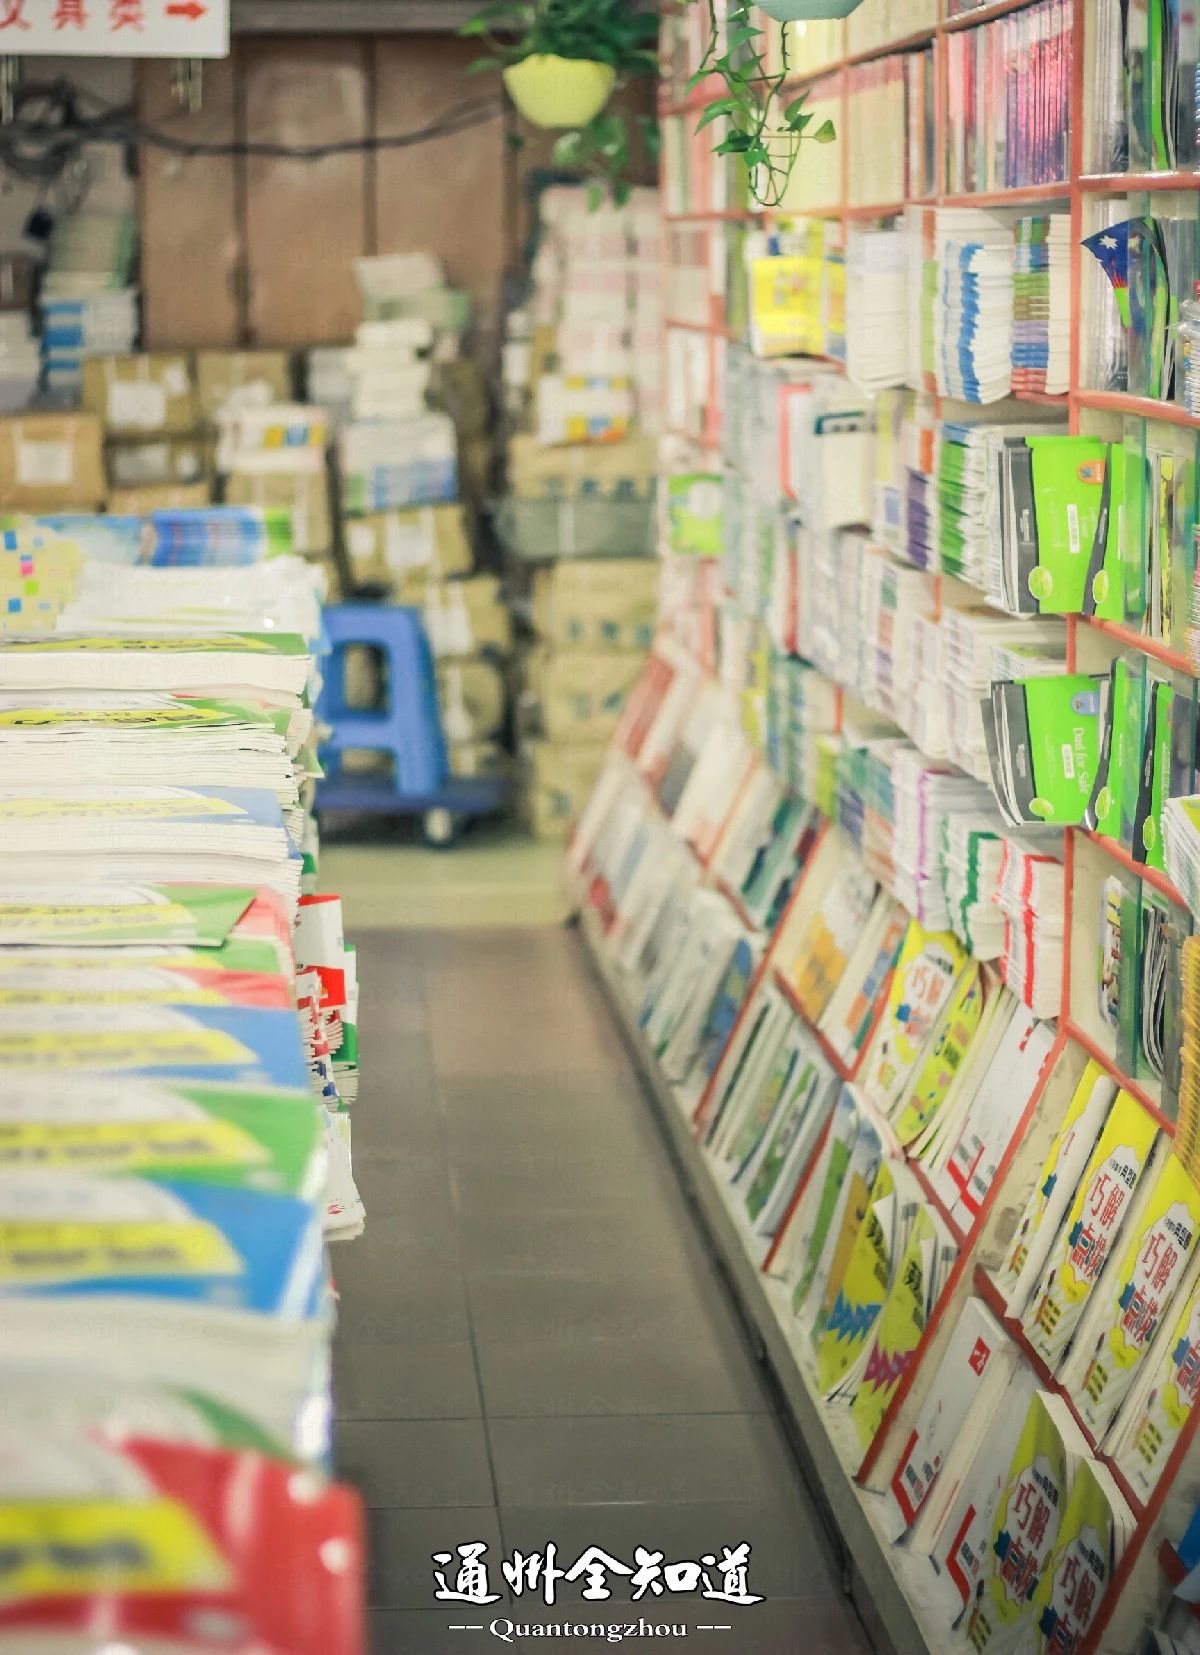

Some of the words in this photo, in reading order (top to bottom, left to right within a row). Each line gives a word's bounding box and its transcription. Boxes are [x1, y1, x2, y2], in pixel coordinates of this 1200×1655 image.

[1089, 1172, 1124, 1231] 巧解
[1141, 1231, 1178, 1295] 巧解
[1014, 1482, 1050, 1551] 巧解
